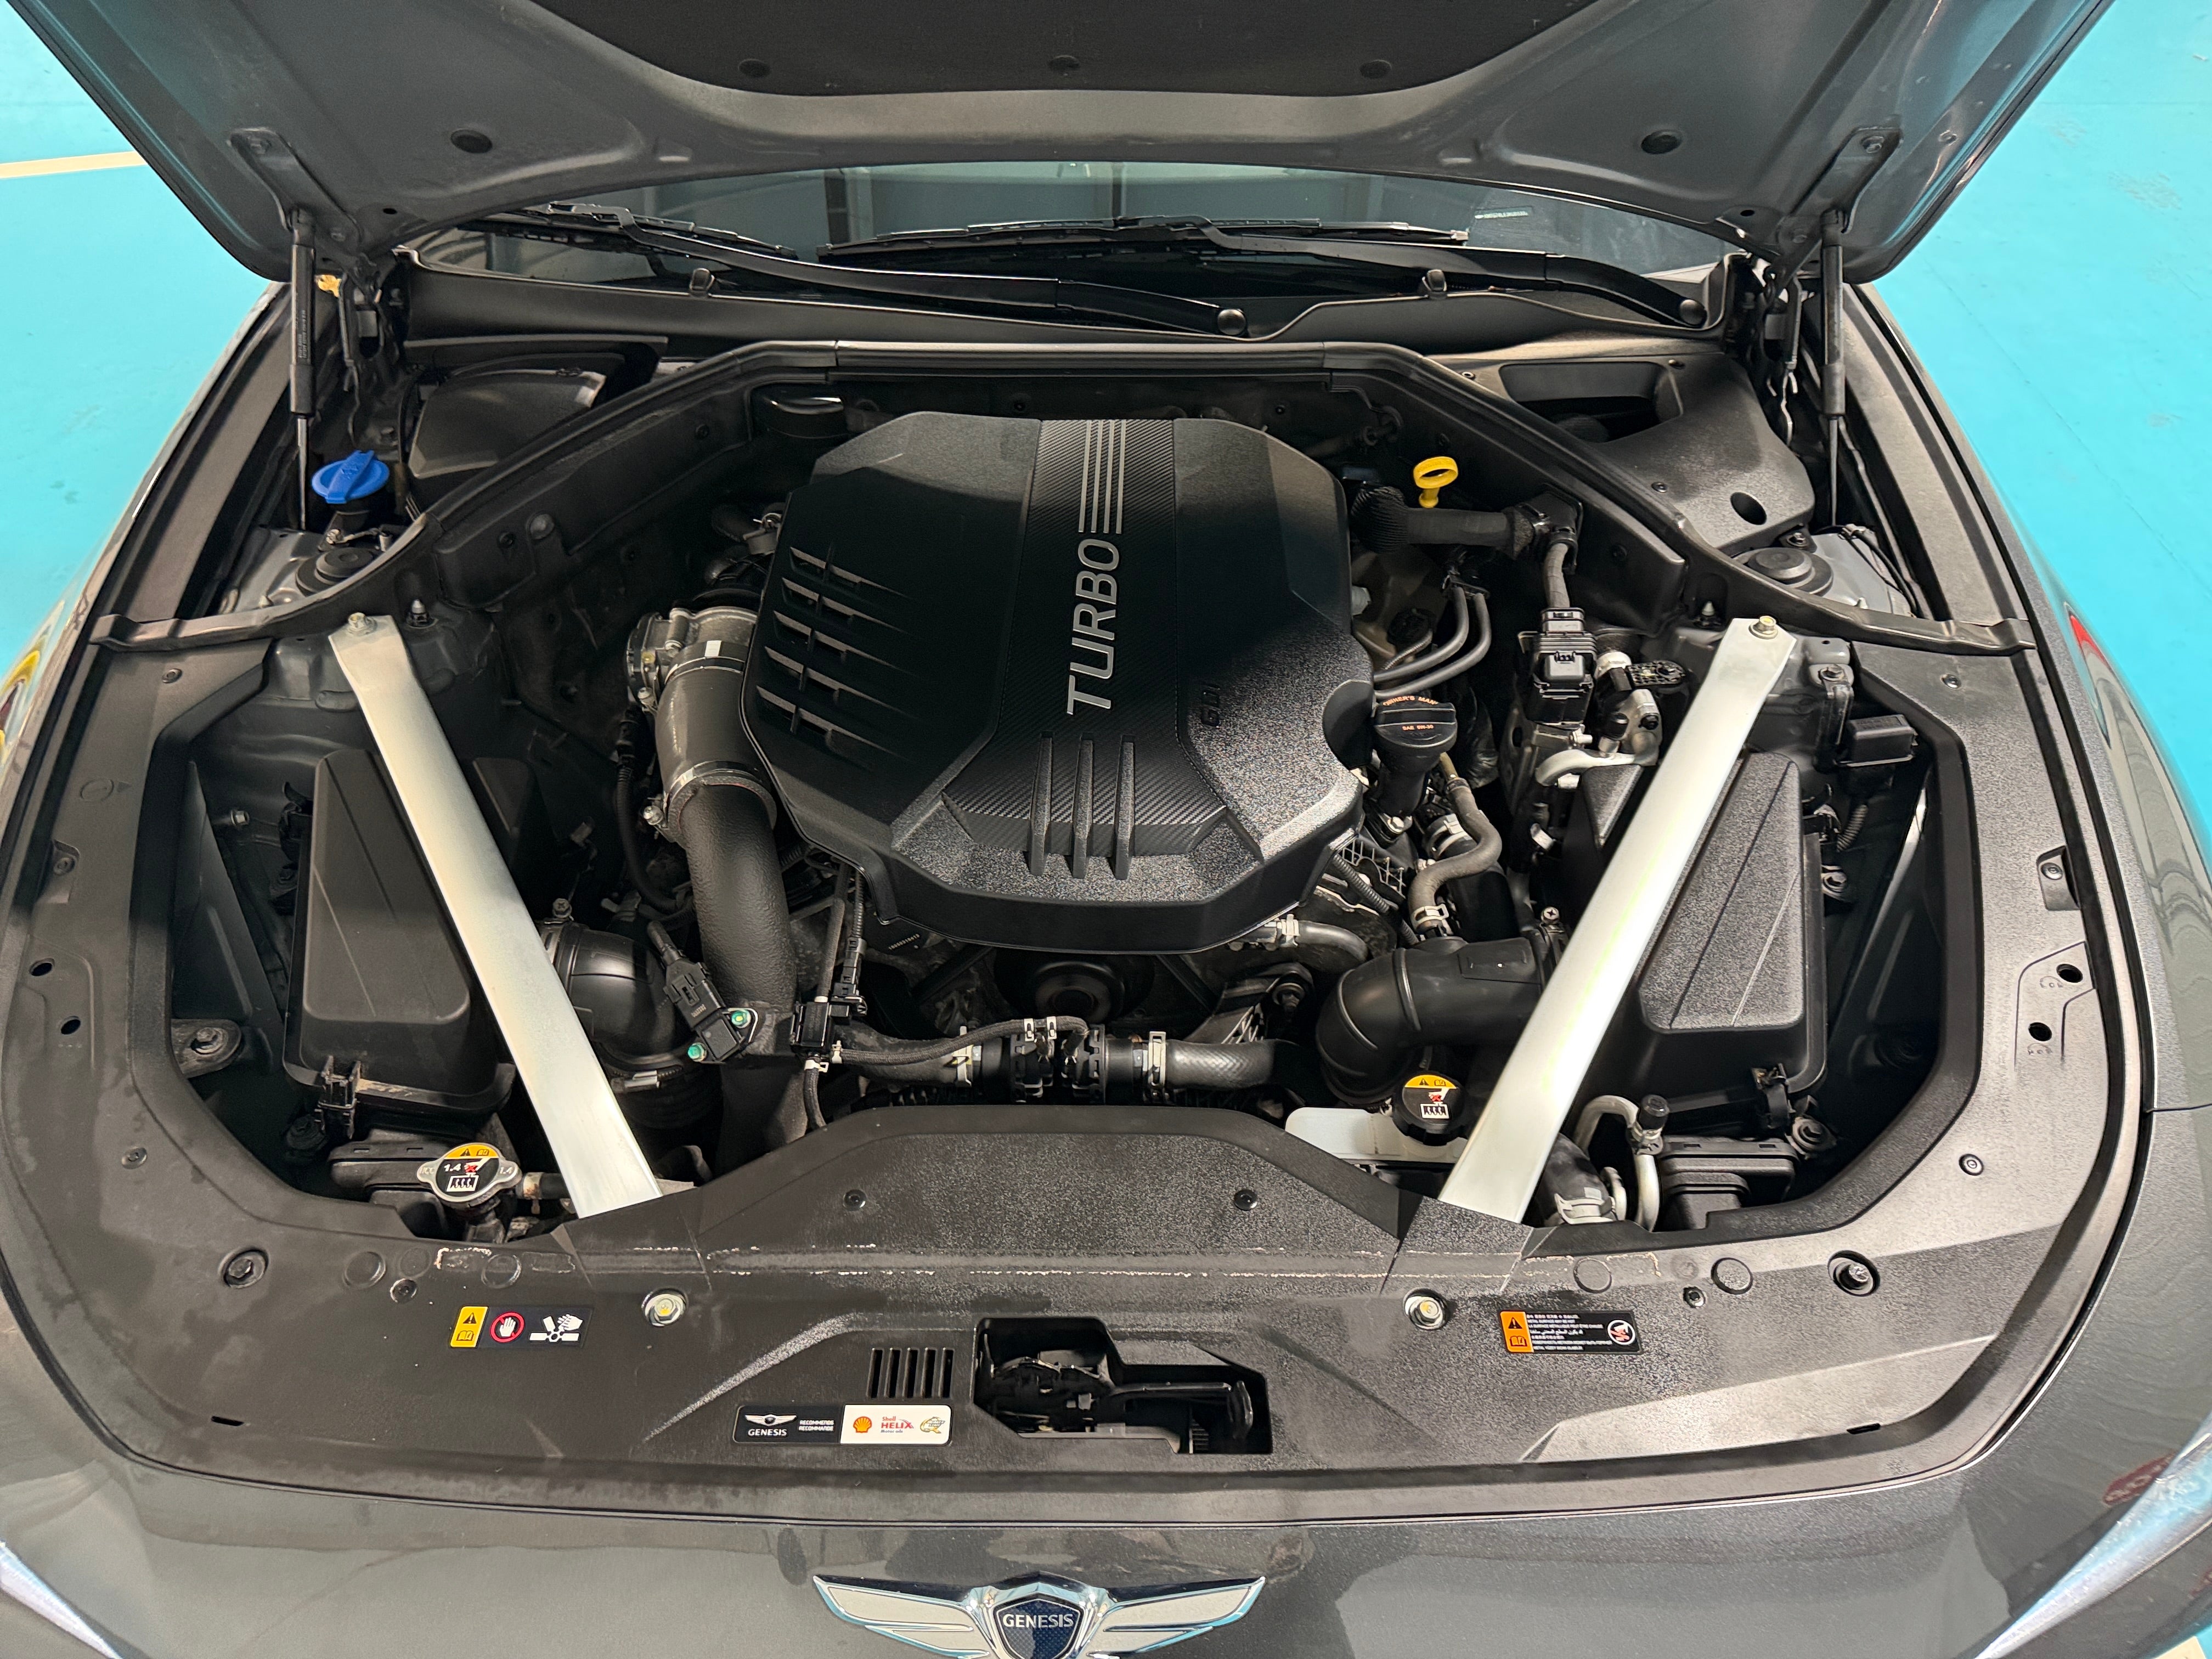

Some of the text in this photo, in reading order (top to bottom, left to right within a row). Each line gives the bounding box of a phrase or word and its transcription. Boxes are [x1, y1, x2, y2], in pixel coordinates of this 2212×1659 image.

[1066, 539, 1119, 715] TURBO
[444, 1163, 461, 1172] 1.4
[500, 1166, 513, 1175] 1.4
[1002, 1613, 1074, 1629] GENESIS
